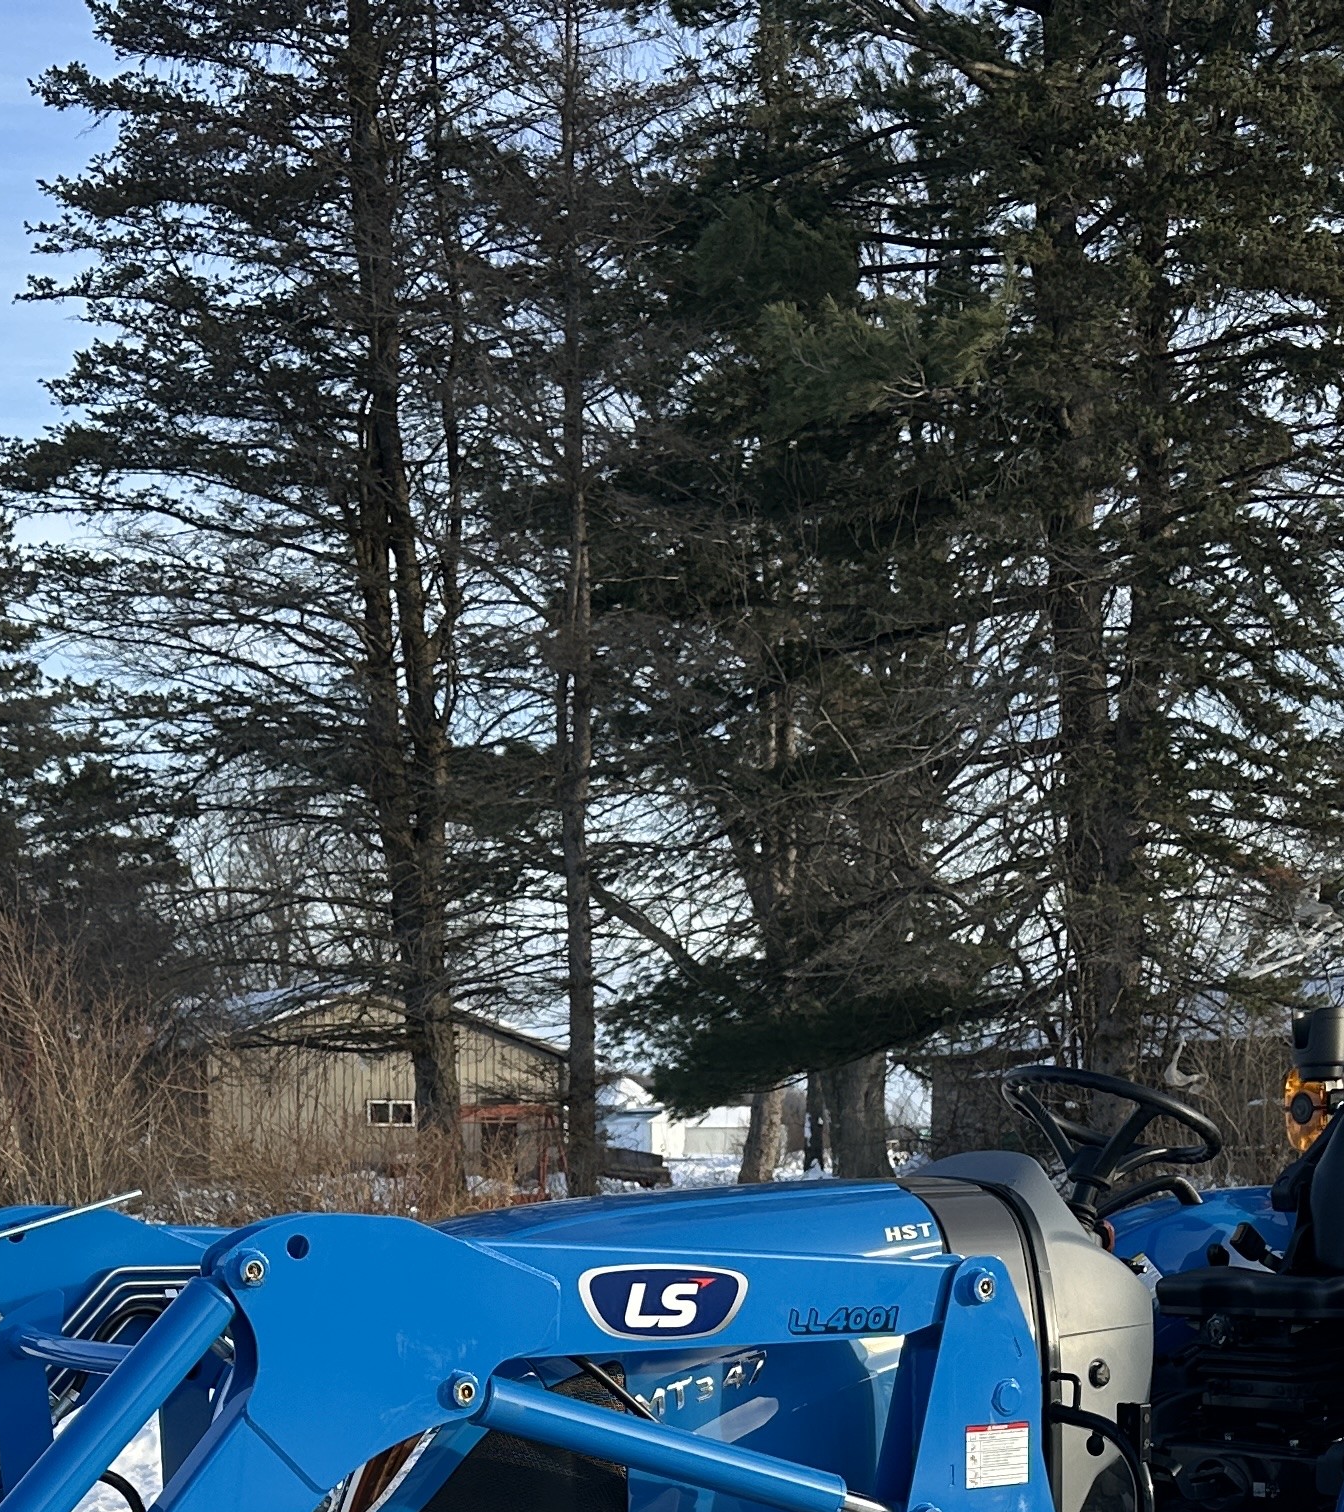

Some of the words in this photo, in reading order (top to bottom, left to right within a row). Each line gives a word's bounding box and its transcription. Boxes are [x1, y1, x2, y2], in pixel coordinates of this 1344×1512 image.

[883, 1222, 932, 1243] HST
[624, 1282, 699, 1329] LS
[787, 1305, 900, 1336] LL4001
